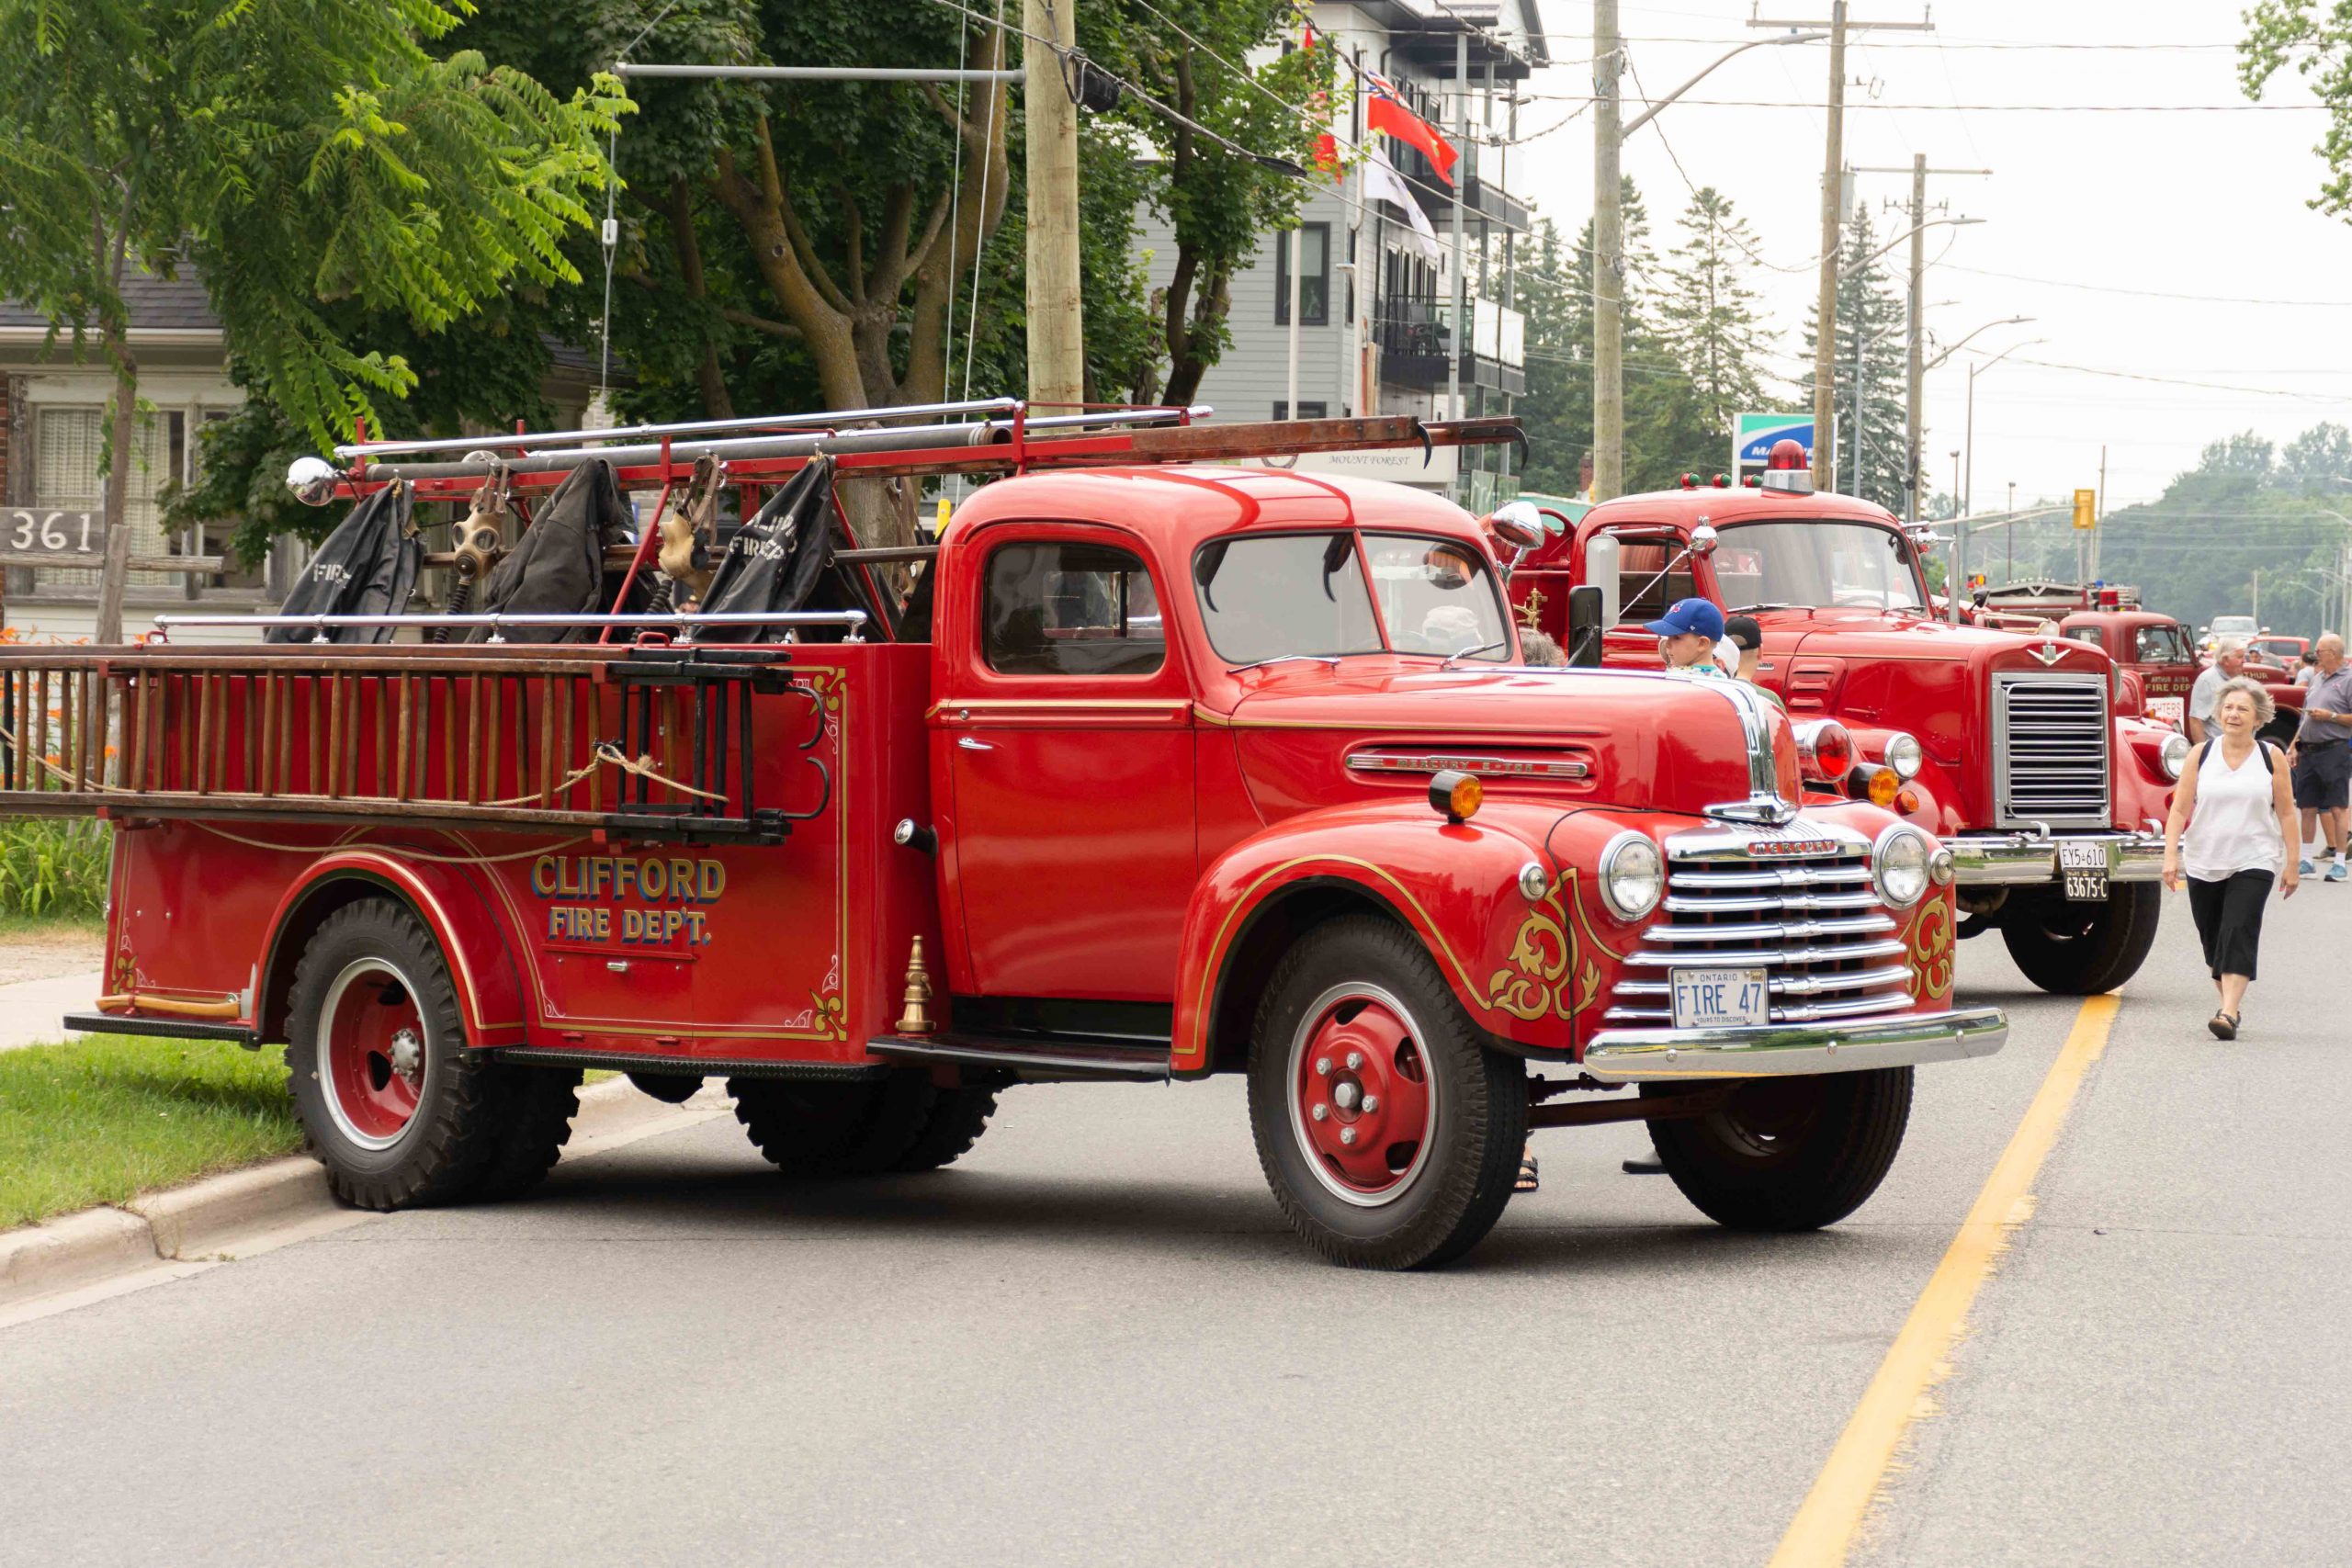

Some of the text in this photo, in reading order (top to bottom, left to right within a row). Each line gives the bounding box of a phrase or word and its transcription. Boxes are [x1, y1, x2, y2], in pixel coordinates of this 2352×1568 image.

[1329, 455, 1411, 466] MOUNT FOREST
[10, 511, 91, 551] 361
[2145, 683, 2192, 692] FIRE DEP
[1755, 840, 1833, 854] MERCURY
[531, 854, 726, 903] CLIFFORD
[548, 907, 611, 943] FIRE
[1700, 974, 1738, 982] ONTARIO
[1677, 983, 1761, 1016] FIRE 47
